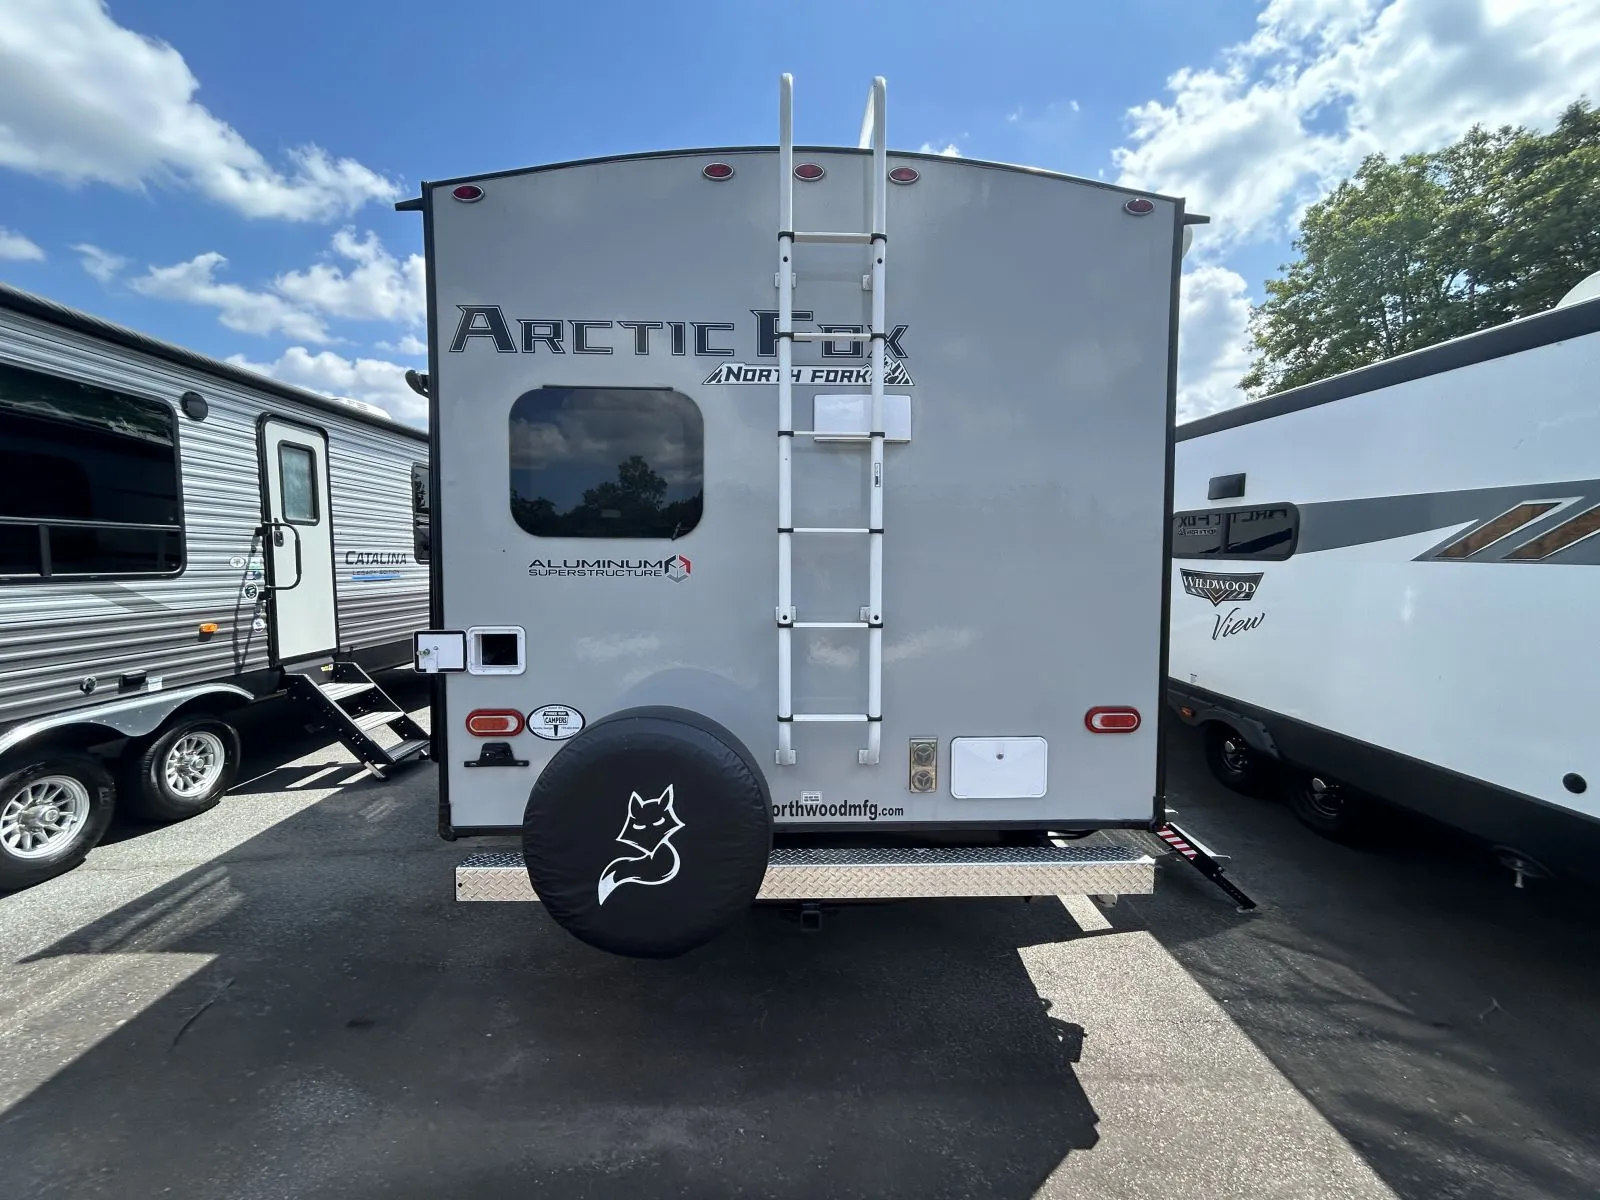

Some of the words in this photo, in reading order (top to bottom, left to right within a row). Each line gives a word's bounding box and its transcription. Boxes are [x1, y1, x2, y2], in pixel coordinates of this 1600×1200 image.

[449, 304, 734, 356] ARCTIC
[810, 369, 870, 383] FORK
[345, 550, 407, 565] CATALINA
[528, 559, 663, 569] ALUMINUM
[528, 569, 663, 577] SUPERSTRUCTURE
[1182, 575, 1256, 593] WILDWOOD
[1212, 607, 1265, 640] View
[772, 799, 904, 821] orthwoodmfg.com
